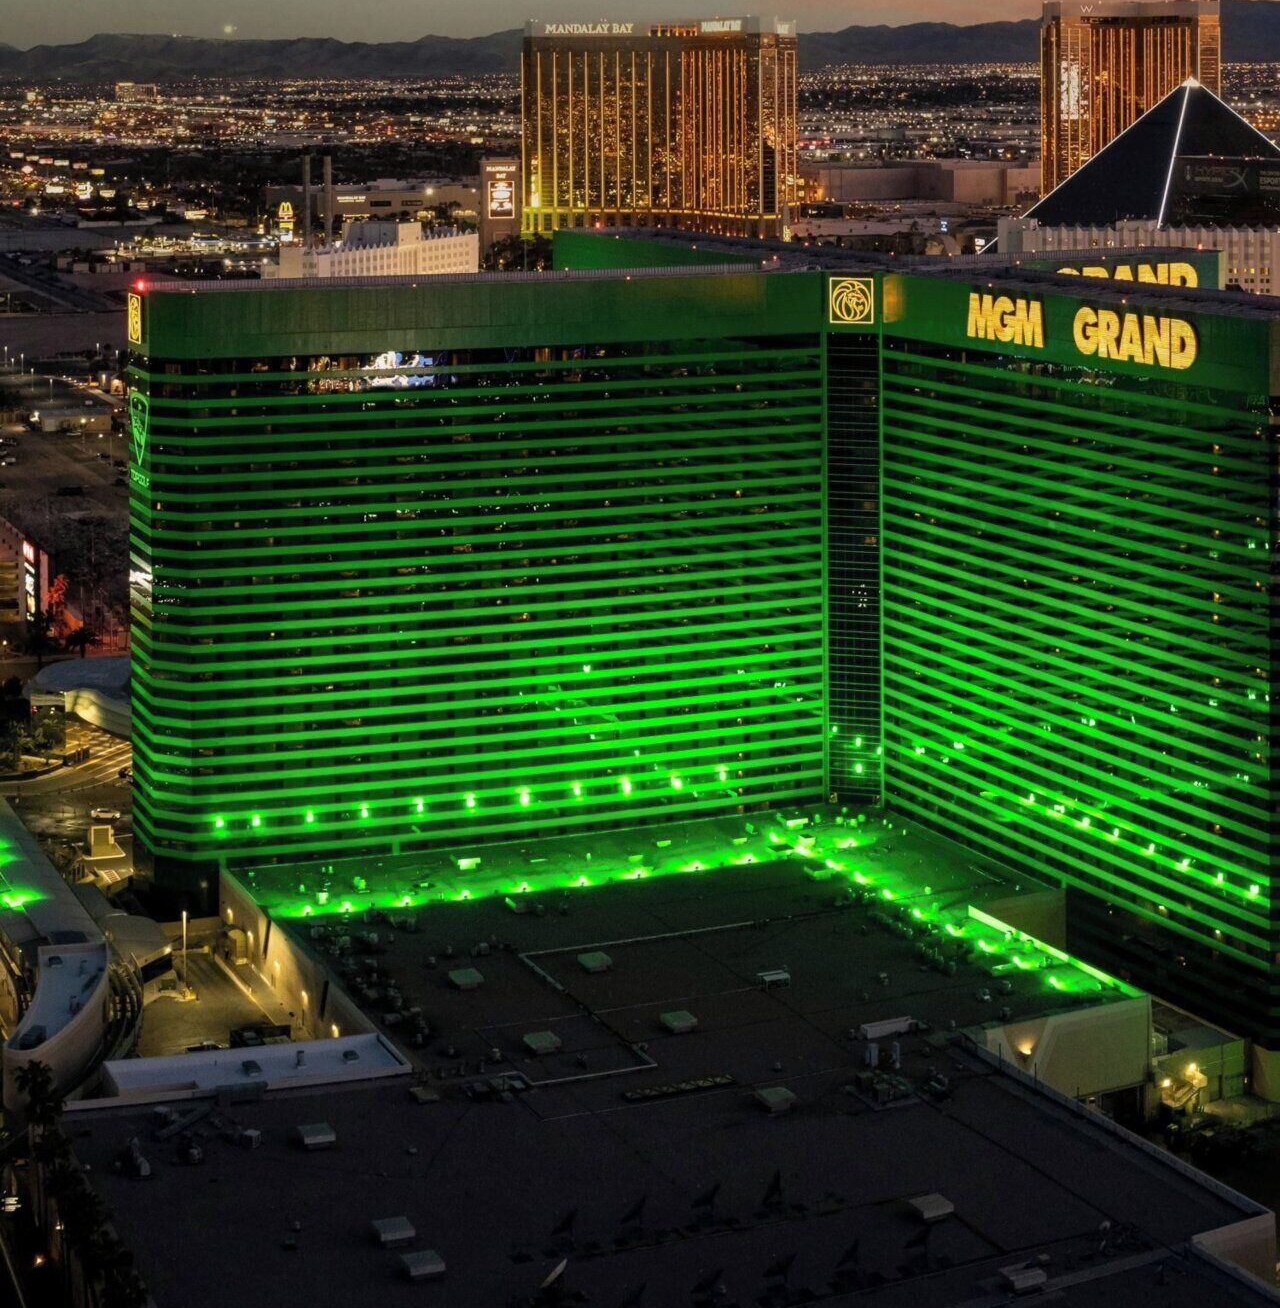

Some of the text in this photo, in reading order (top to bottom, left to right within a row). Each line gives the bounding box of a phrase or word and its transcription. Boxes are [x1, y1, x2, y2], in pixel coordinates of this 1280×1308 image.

[1080, 5, 1094, 13] W
[545, 23, 634, 34] MANDALAY BAY
[967, 292, 1198, 370] MGM GRAND
[130, 468, 150, 488] TOPGOLF
